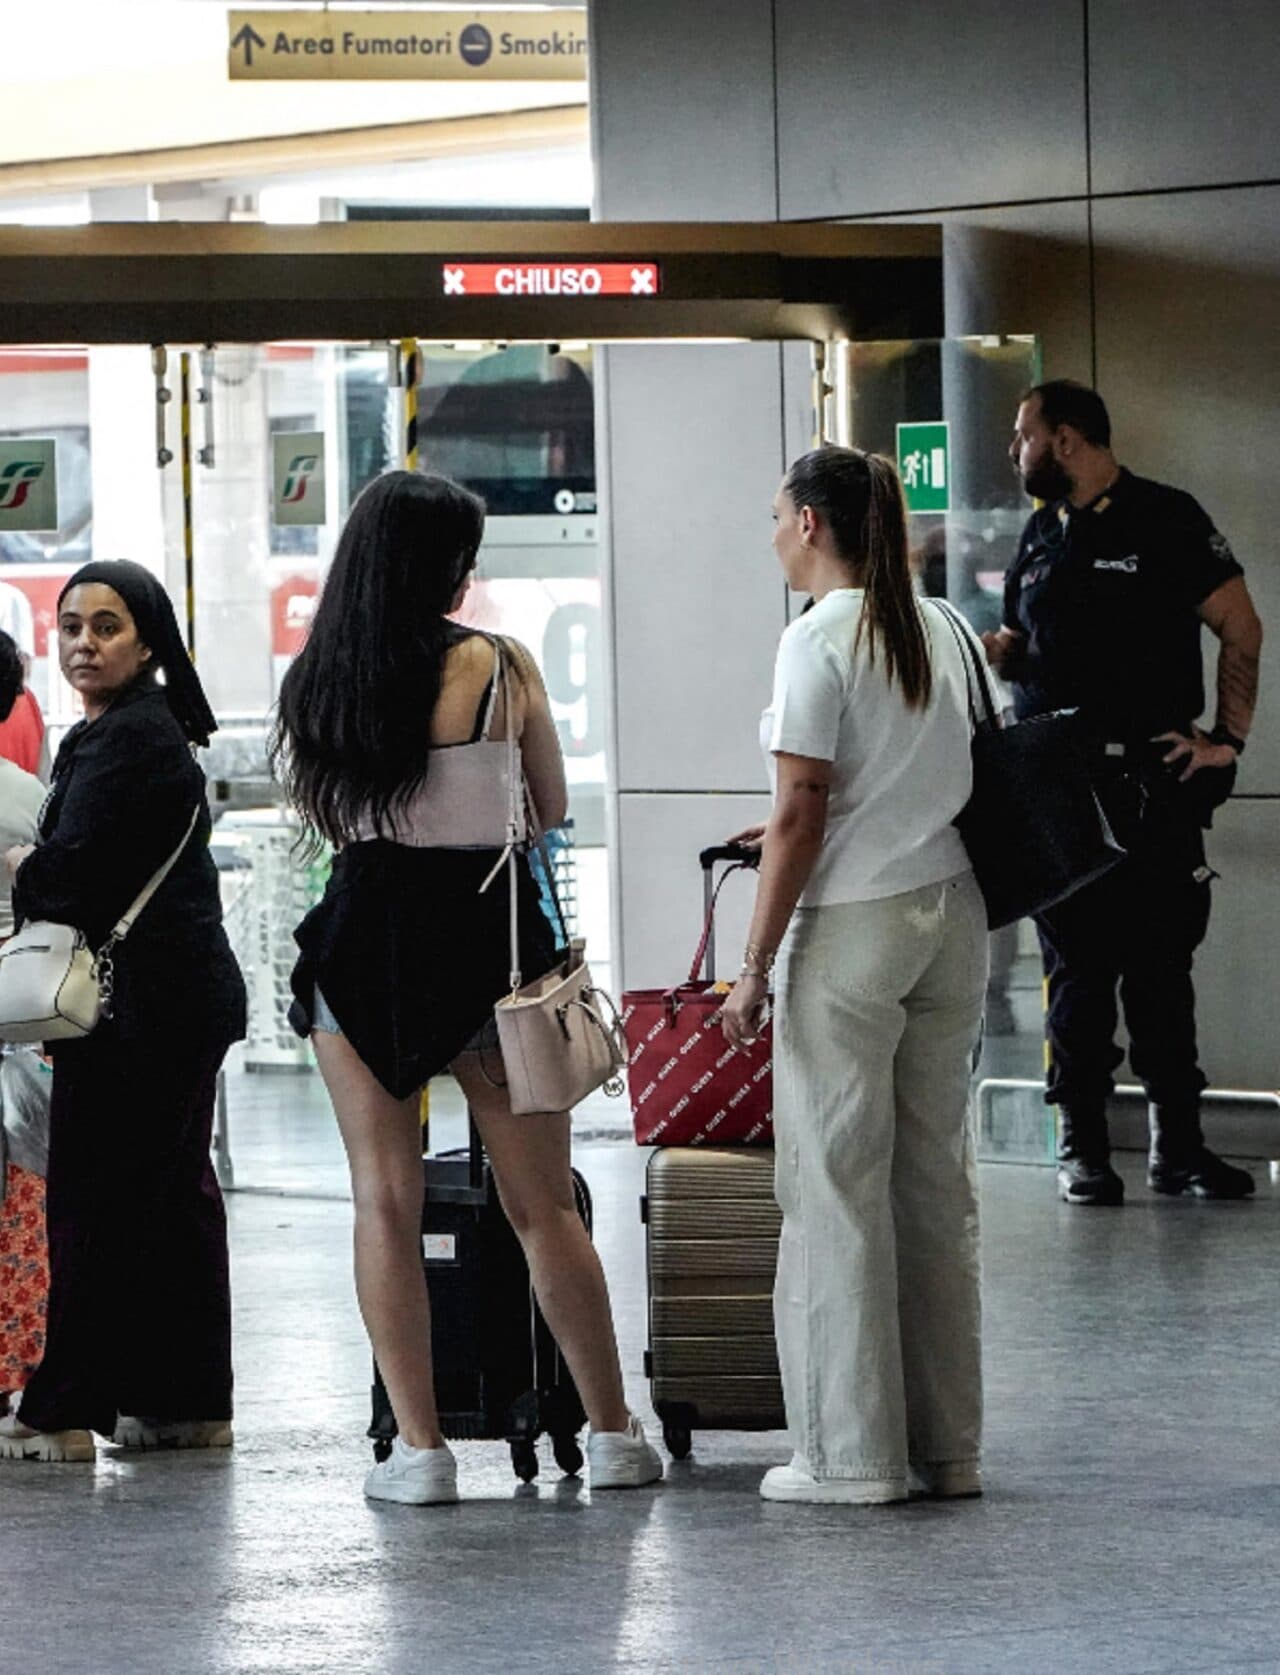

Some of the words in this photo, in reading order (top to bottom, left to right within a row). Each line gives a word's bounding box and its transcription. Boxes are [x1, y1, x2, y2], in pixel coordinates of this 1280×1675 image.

[272, 32, 334, 56] Area
[343, 32, 452, 56] Fumatori
[495, 268, 602, 294] CHIUSO
[679, 1032, 701, 1055] GUESS
[690, 1070, 713, 1094] GUESS
